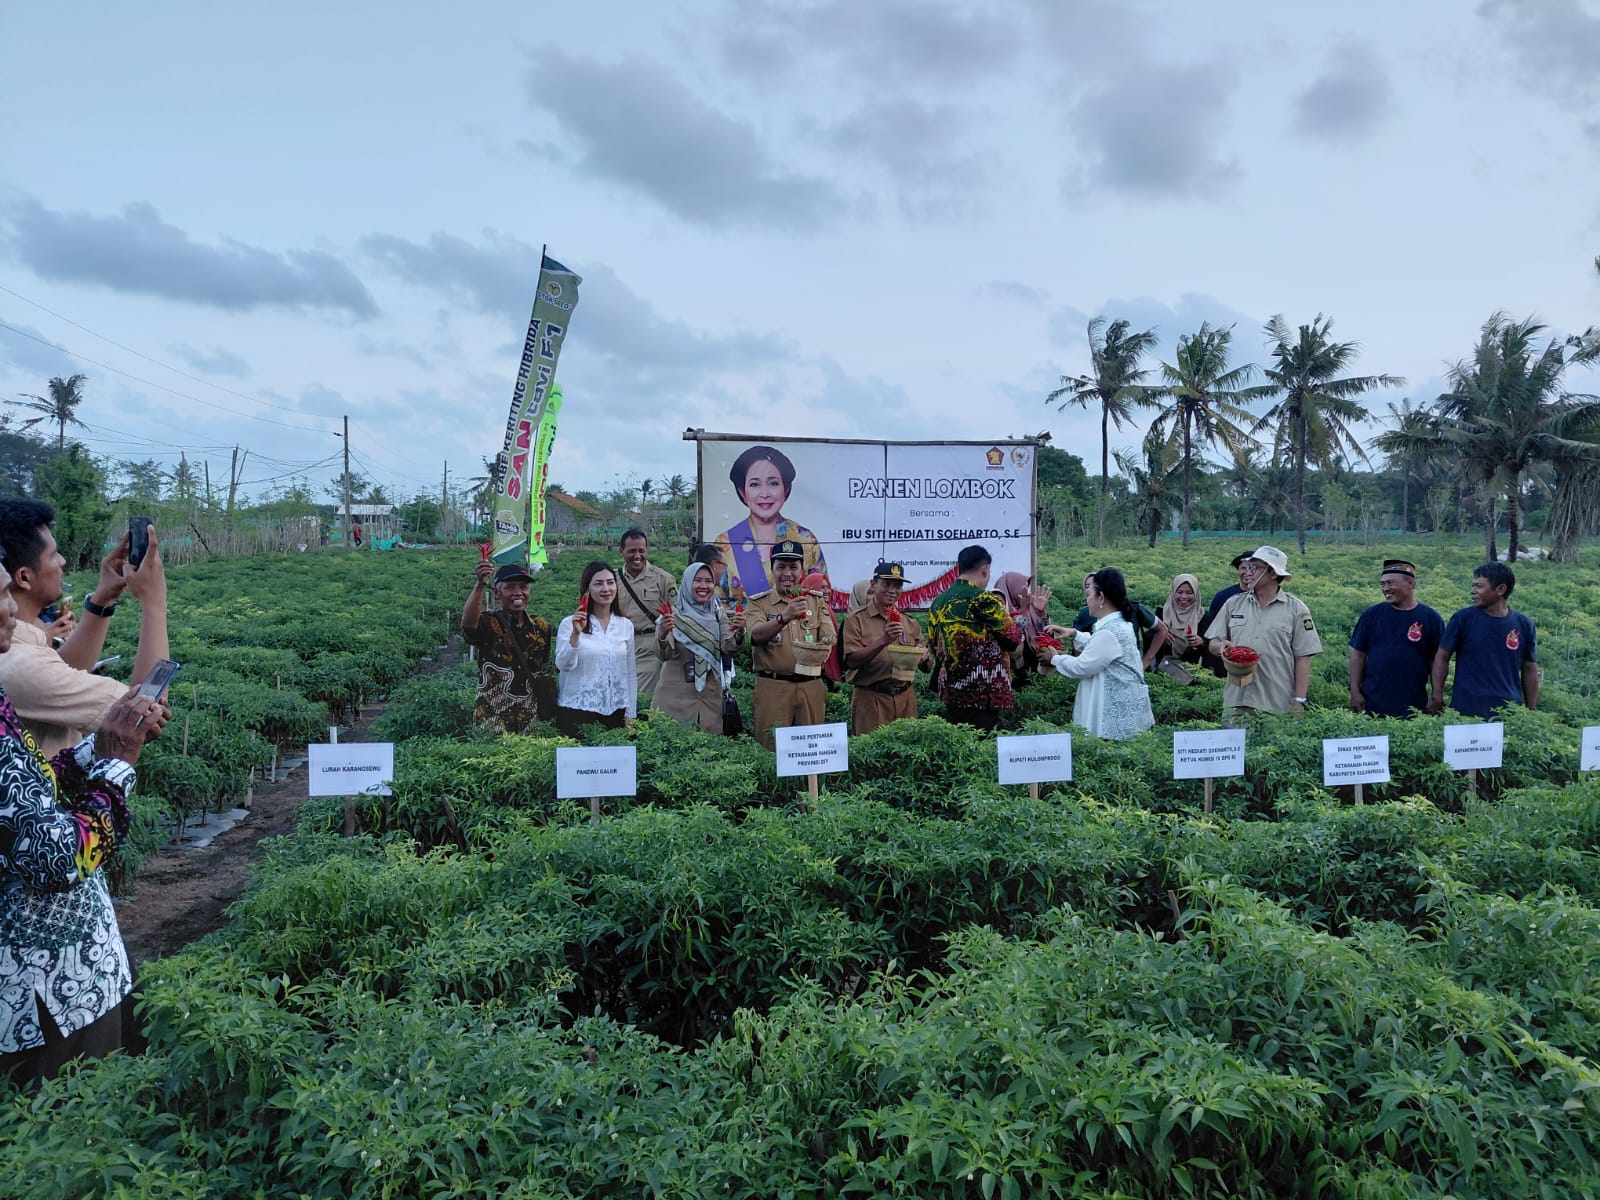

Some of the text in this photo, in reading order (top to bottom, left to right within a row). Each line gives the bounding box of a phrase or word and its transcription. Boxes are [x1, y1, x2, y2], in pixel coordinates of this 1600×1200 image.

[498, 320, 540, 494] CABE KERITING HIBRIDA
[508, 420, 532, 499] SAN
[541, 324, 562, 359] F1
[842, 529, 1020, 540] IBU SITI HEDIATI SOEHARTO, S.E
[849, 478, 1015, 498] PANEN LOMBOK
